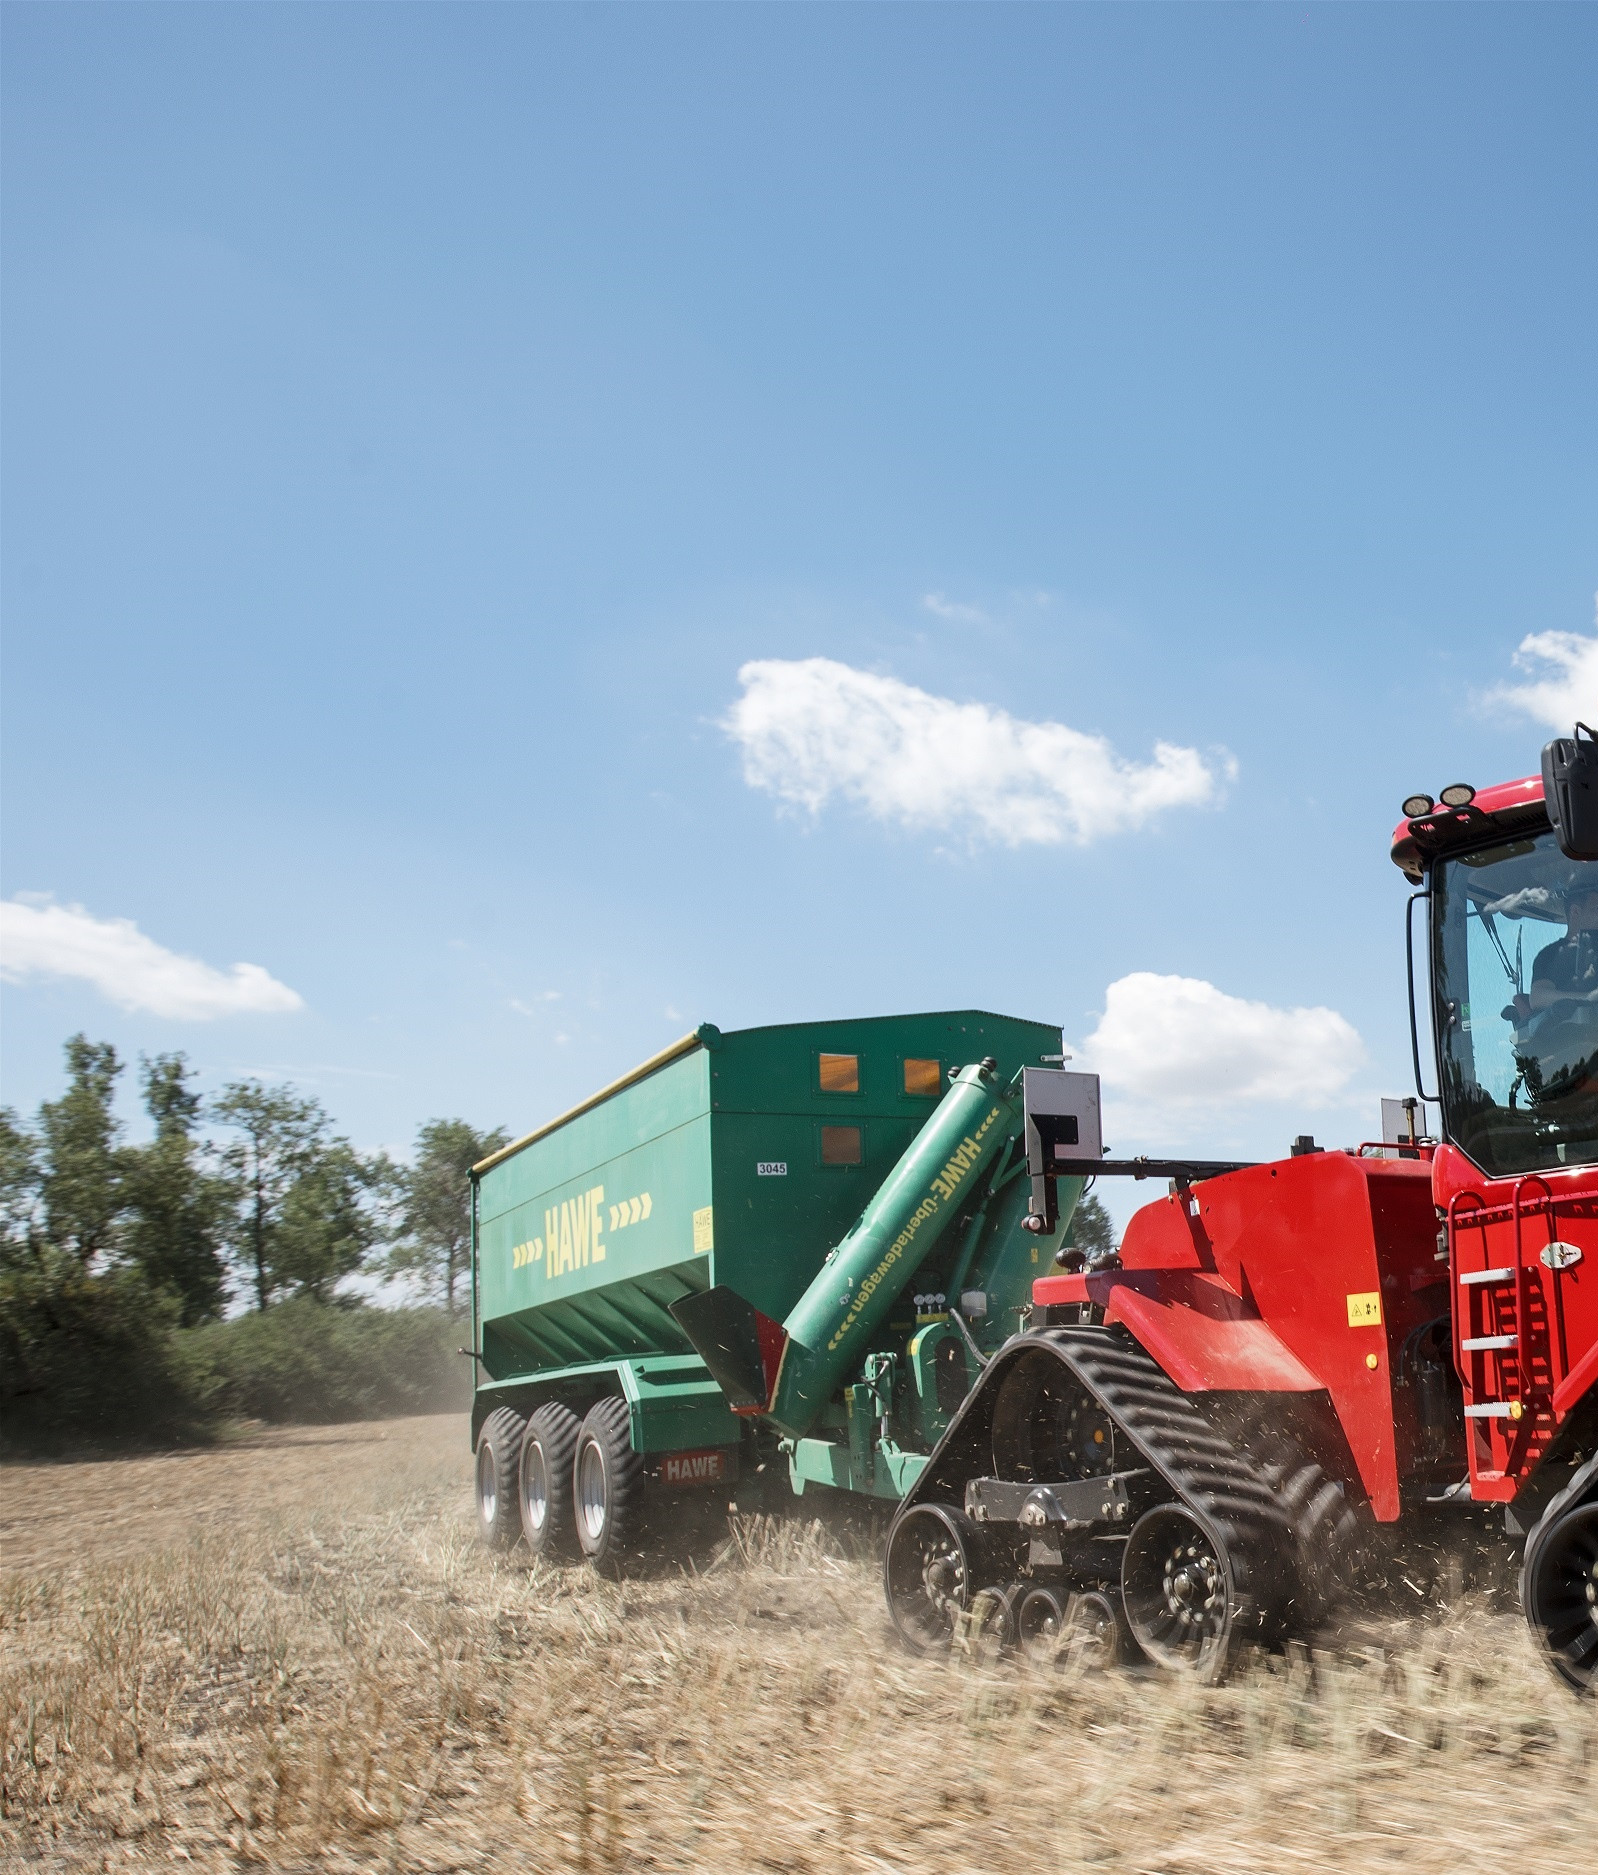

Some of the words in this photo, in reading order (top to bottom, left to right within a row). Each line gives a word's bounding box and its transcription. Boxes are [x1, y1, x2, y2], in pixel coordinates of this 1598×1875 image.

[759, 1163, 786, 1174] 3045
[545, 1184, 606, 1279] HAWE
[667, 1455, 719, 1480] HAWE
